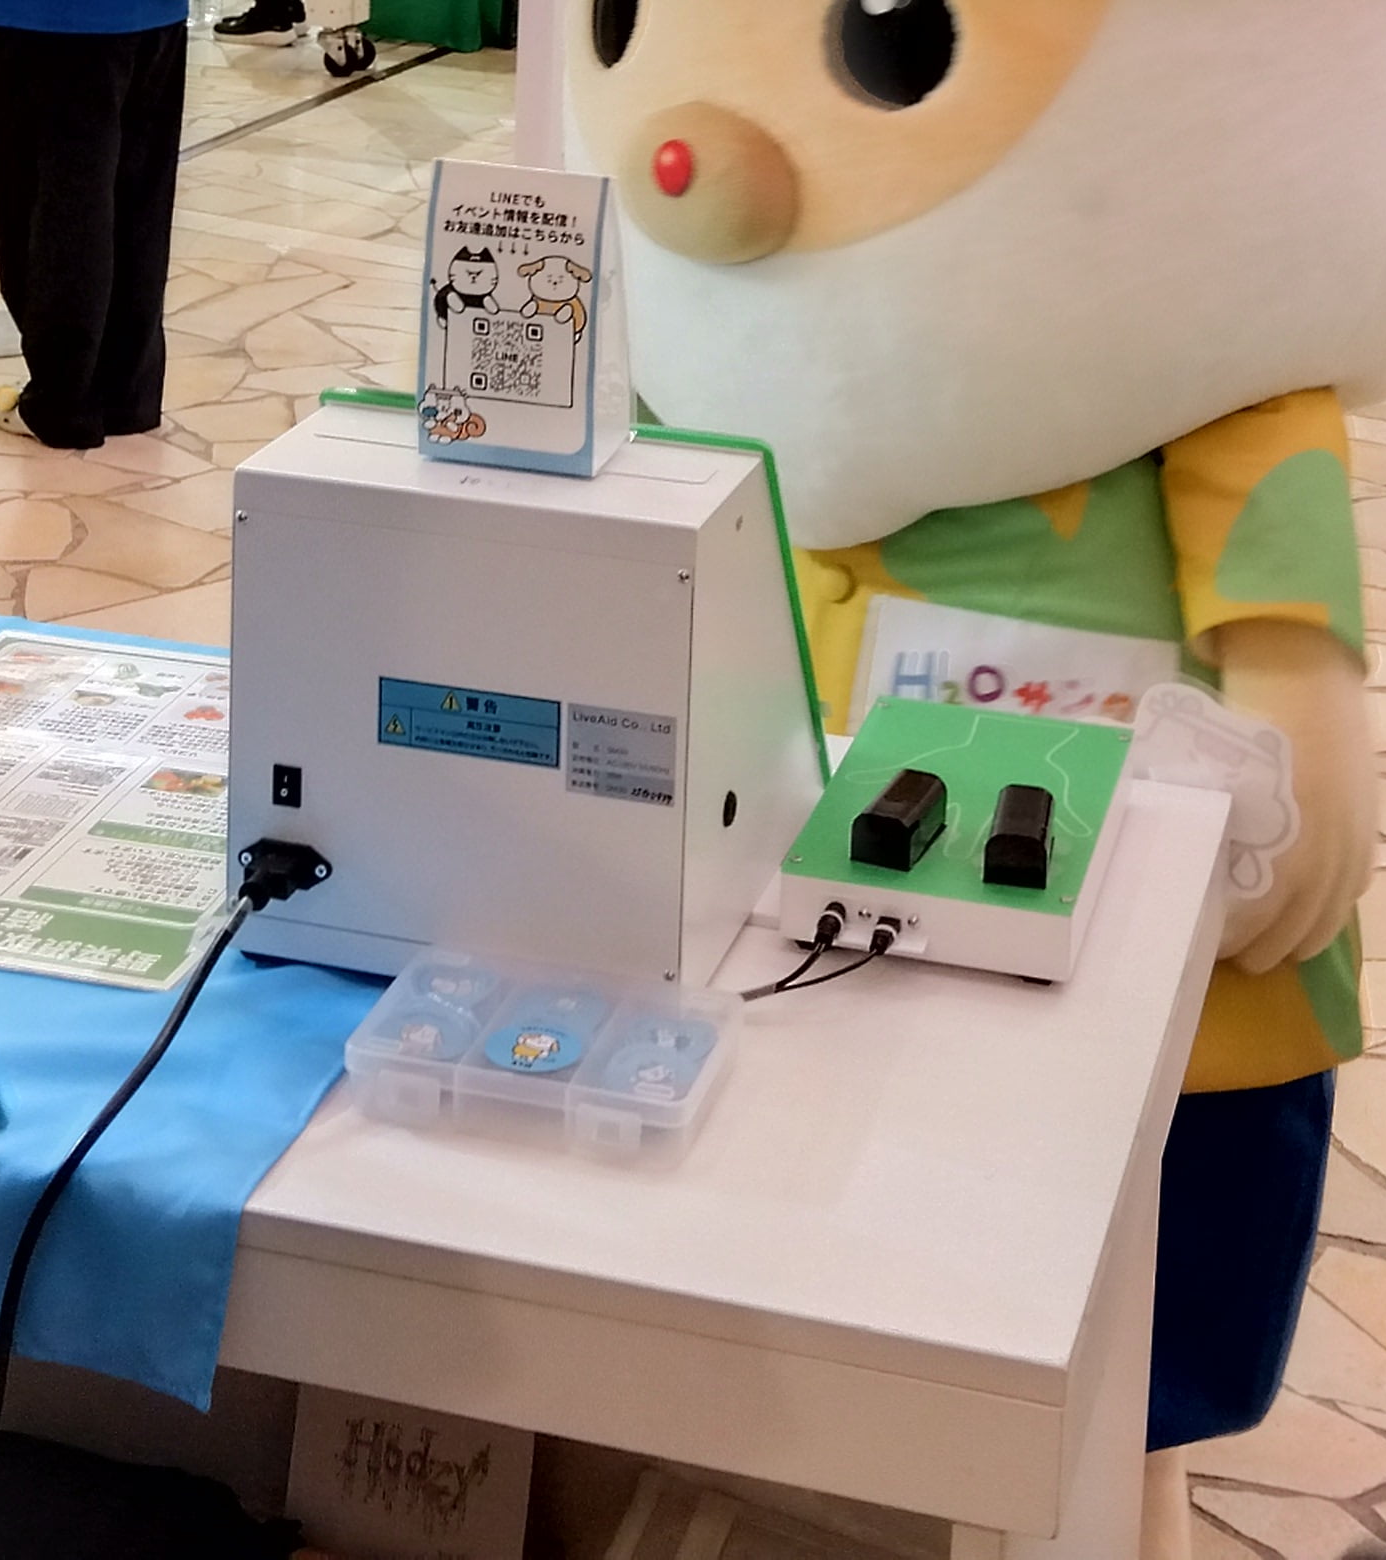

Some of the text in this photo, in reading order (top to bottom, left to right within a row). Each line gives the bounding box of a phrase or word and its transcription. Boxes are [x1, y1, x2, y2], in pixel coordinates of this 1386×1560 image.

[489, 191, 546, 208] LINEでも
[452, 204, 578, 228] イベント情報を配信！
[443, 219, 586, 246] お友達追加はこちらから
[495, 351, 519, 363] LINE
[465, 696, 498, 715] 警告
